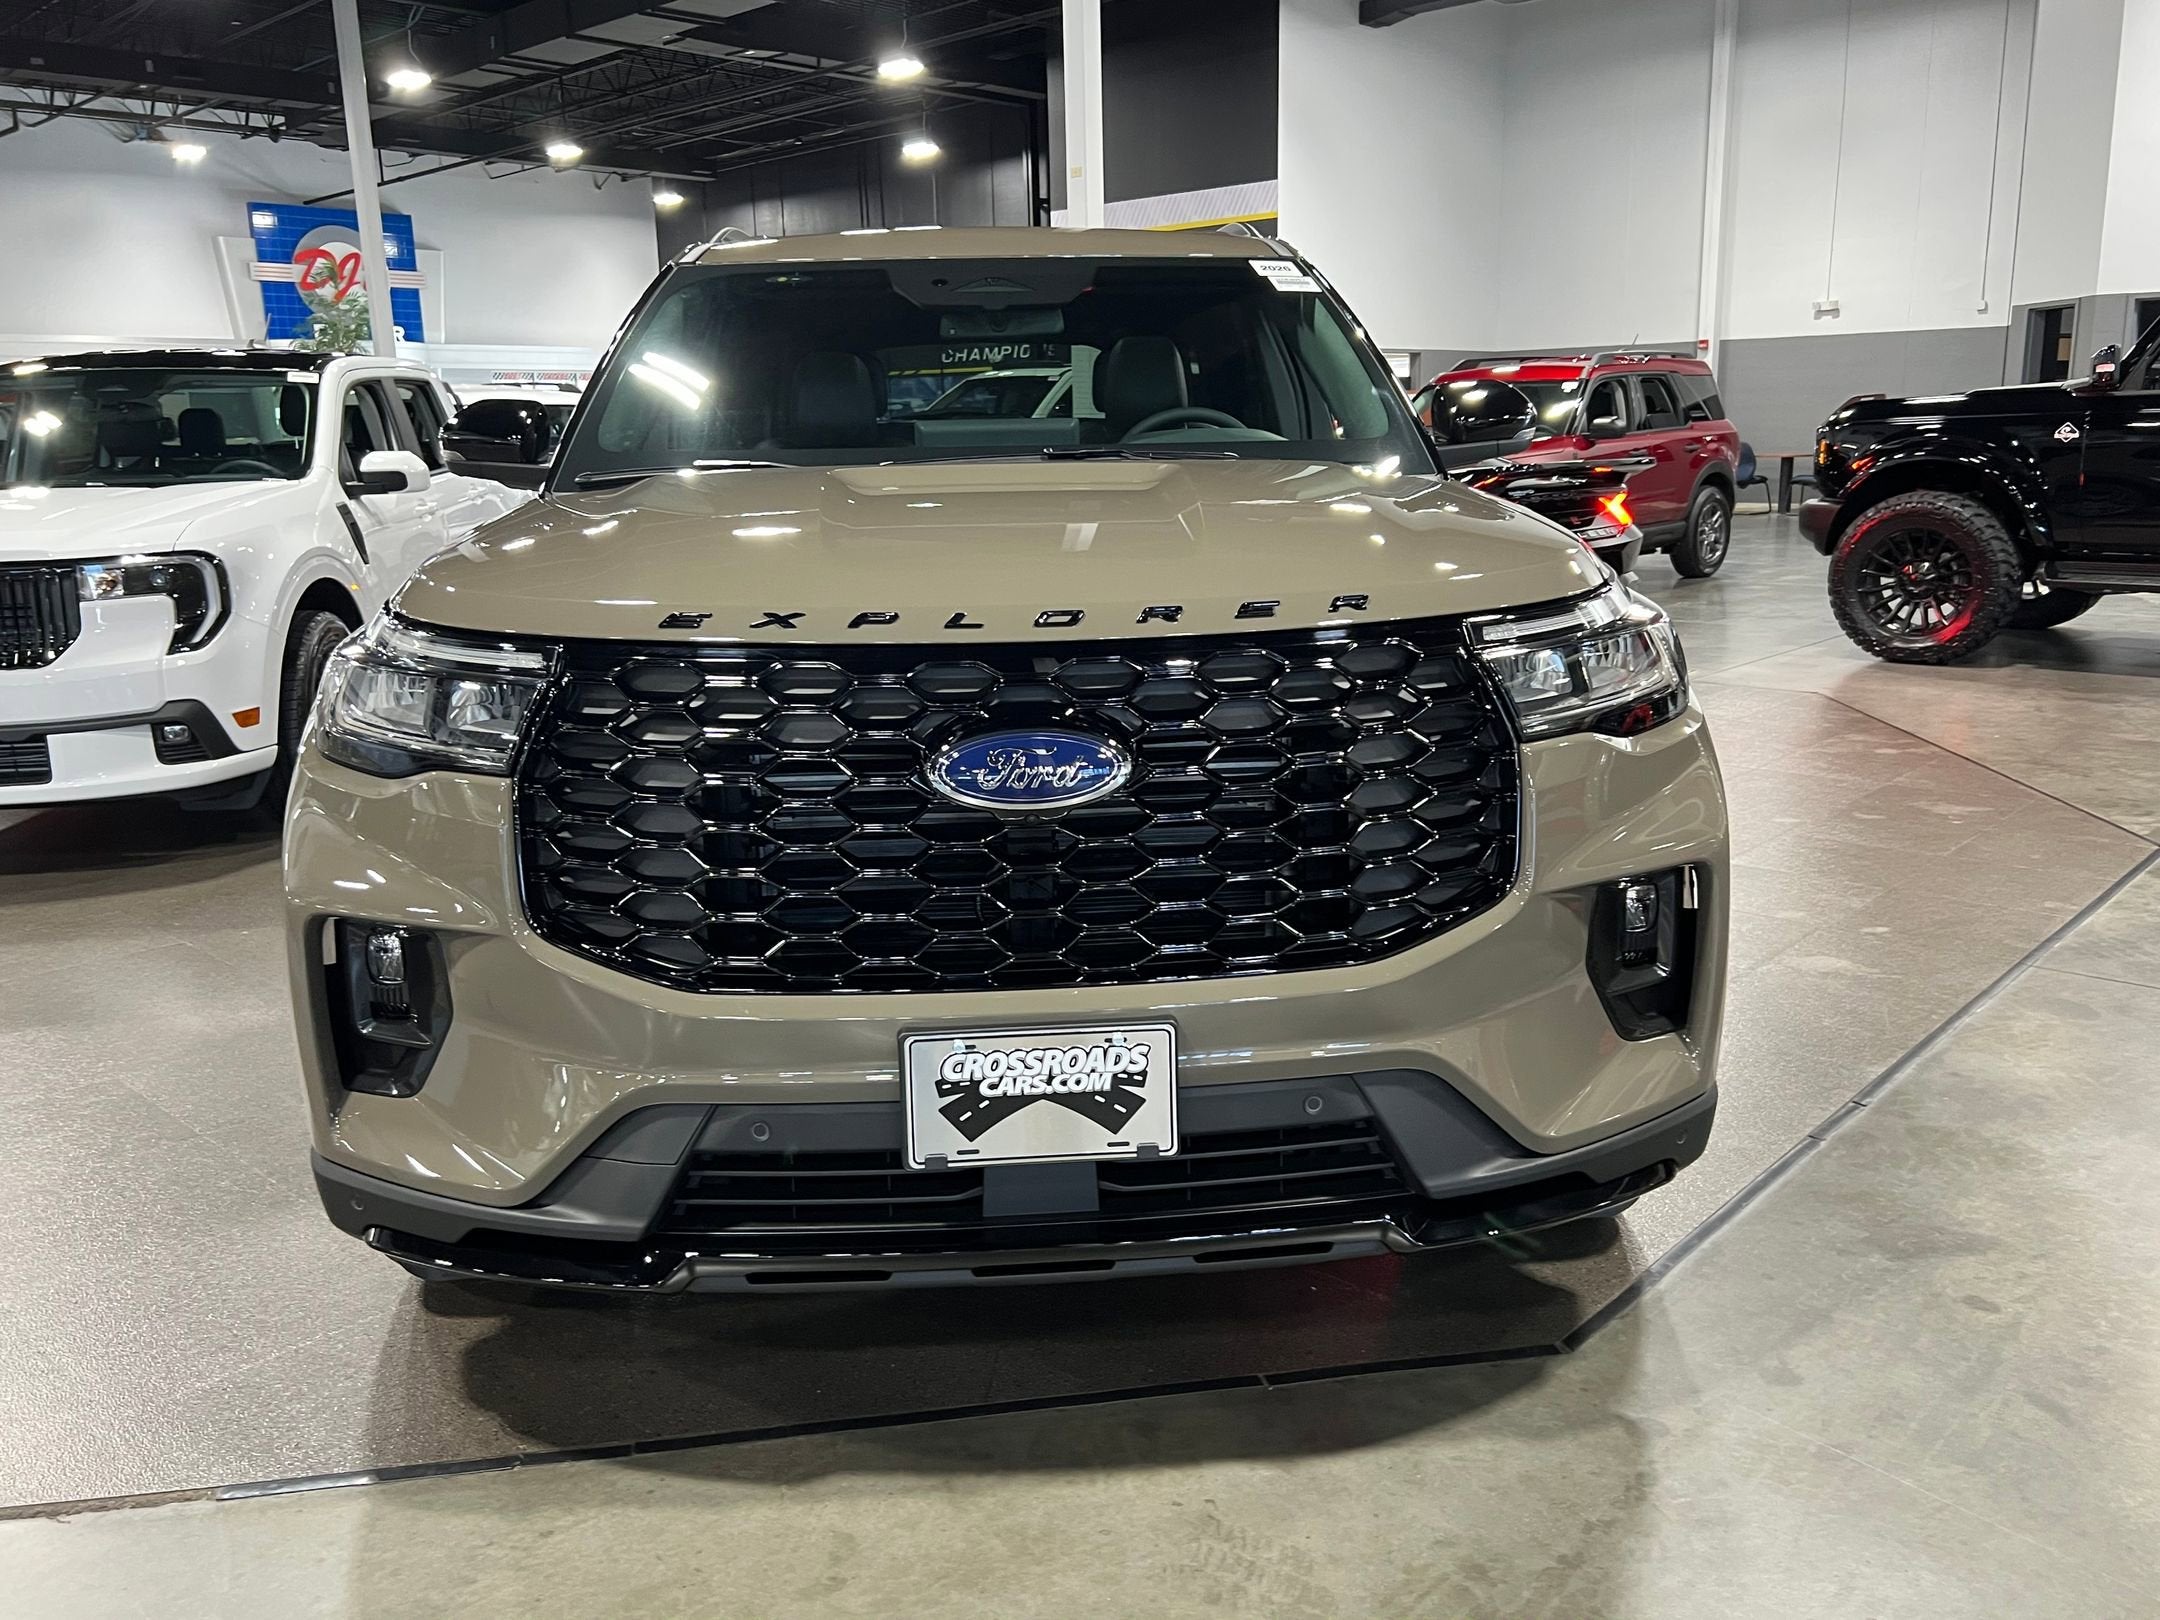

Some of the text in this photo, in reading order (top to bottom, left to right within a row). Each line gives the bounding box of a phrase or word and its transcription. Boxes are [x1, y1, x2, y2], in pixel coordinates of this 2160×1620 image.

[294, 247, 368, 305] DJ
[658, 594, 1369, 629] EXPLORER
[973, 747, 1088, 790] Ford
[940, 1043, 1150, 1082] CROSSROADS
[979, 1072, 1114, 1097] CARS.COM
